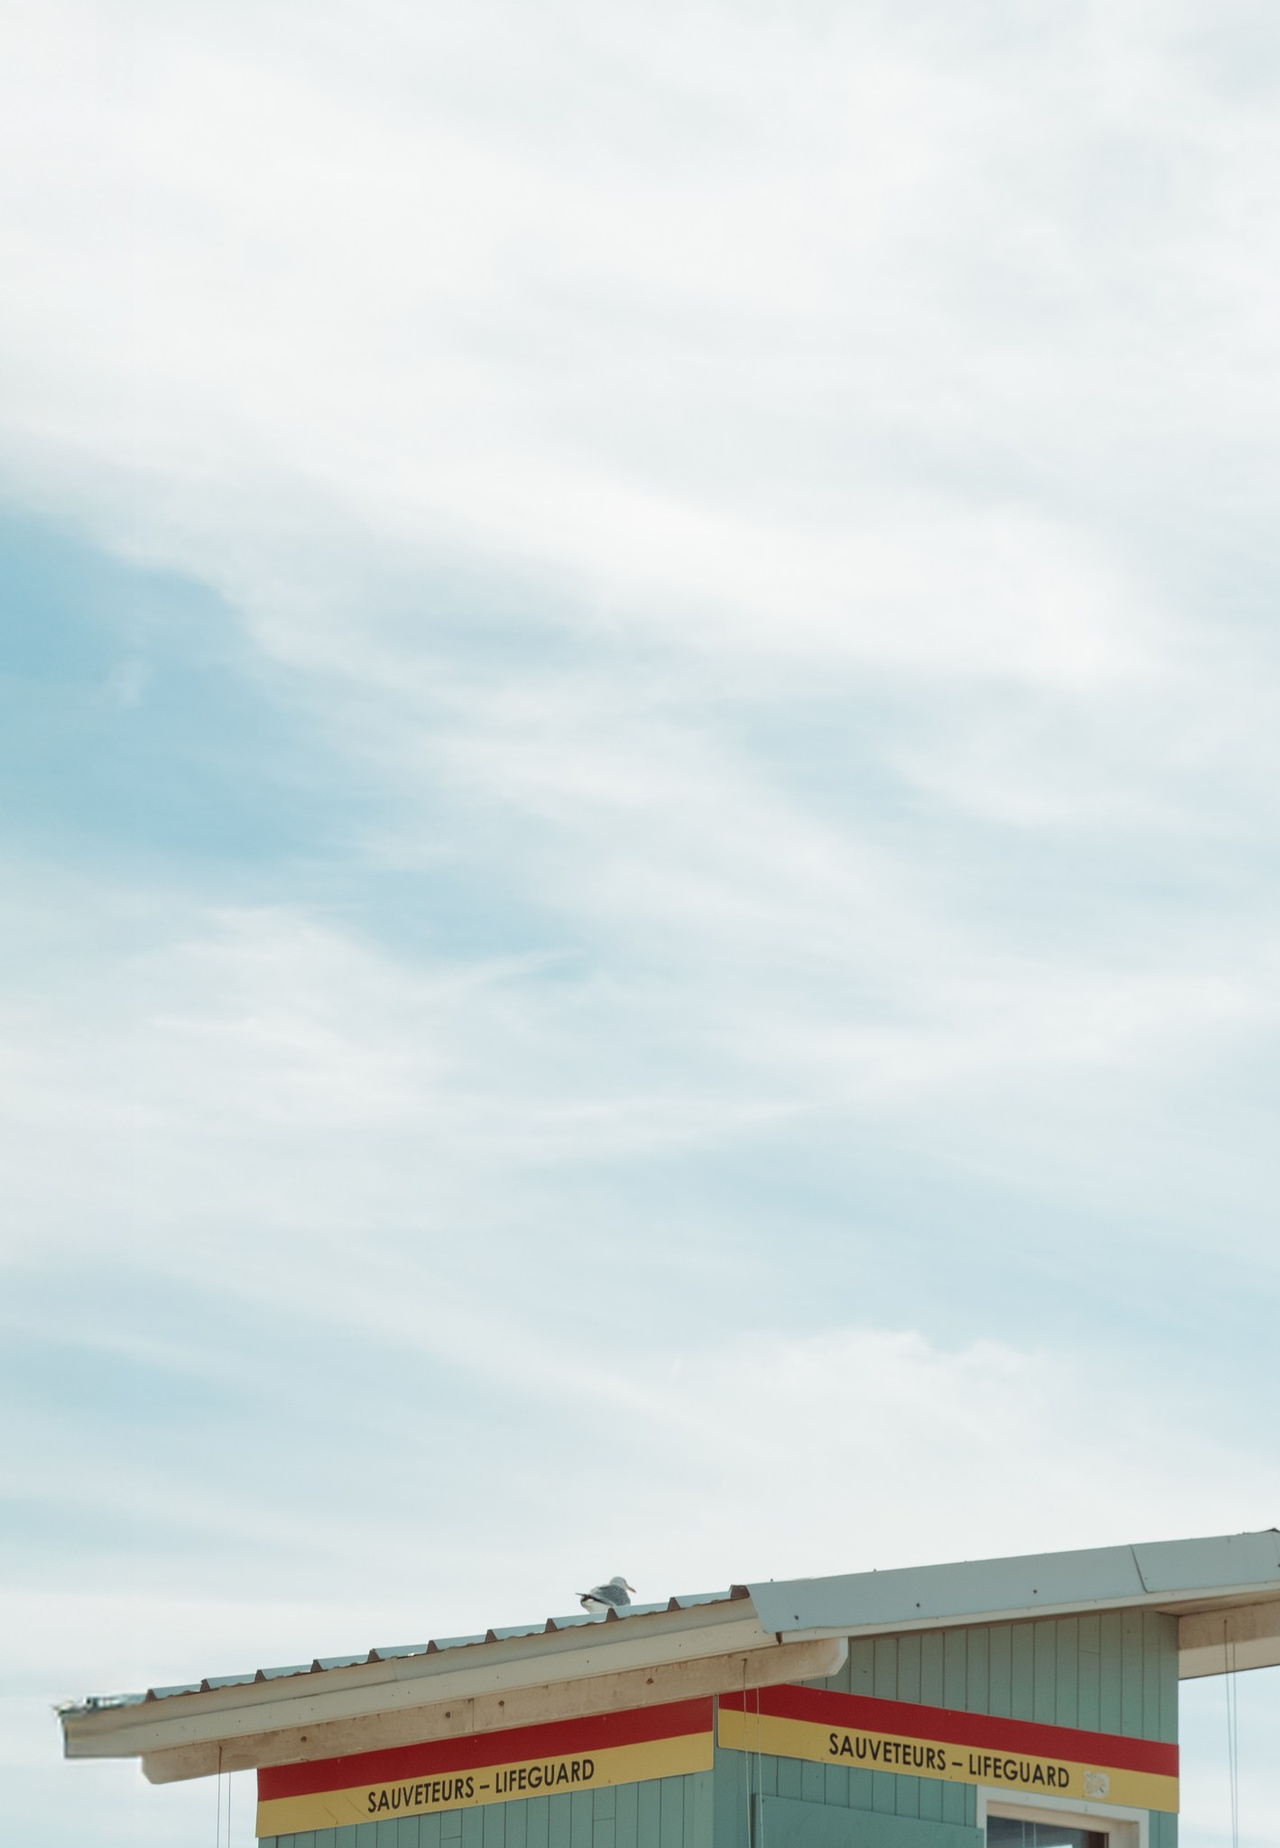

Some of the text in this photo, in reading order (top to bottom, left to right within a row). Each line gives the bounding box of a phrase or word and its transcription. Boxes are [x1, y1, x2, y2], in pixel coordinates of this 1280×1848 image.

[367, 1776, 475, 1814] SAUVETEURS
[494, 1758, 596, 1794] LIFEGUARD
[829, 1732, 947, 1771] SAUVETEURS
[968, 1753, 1070, 1789] LIFEGUARD
